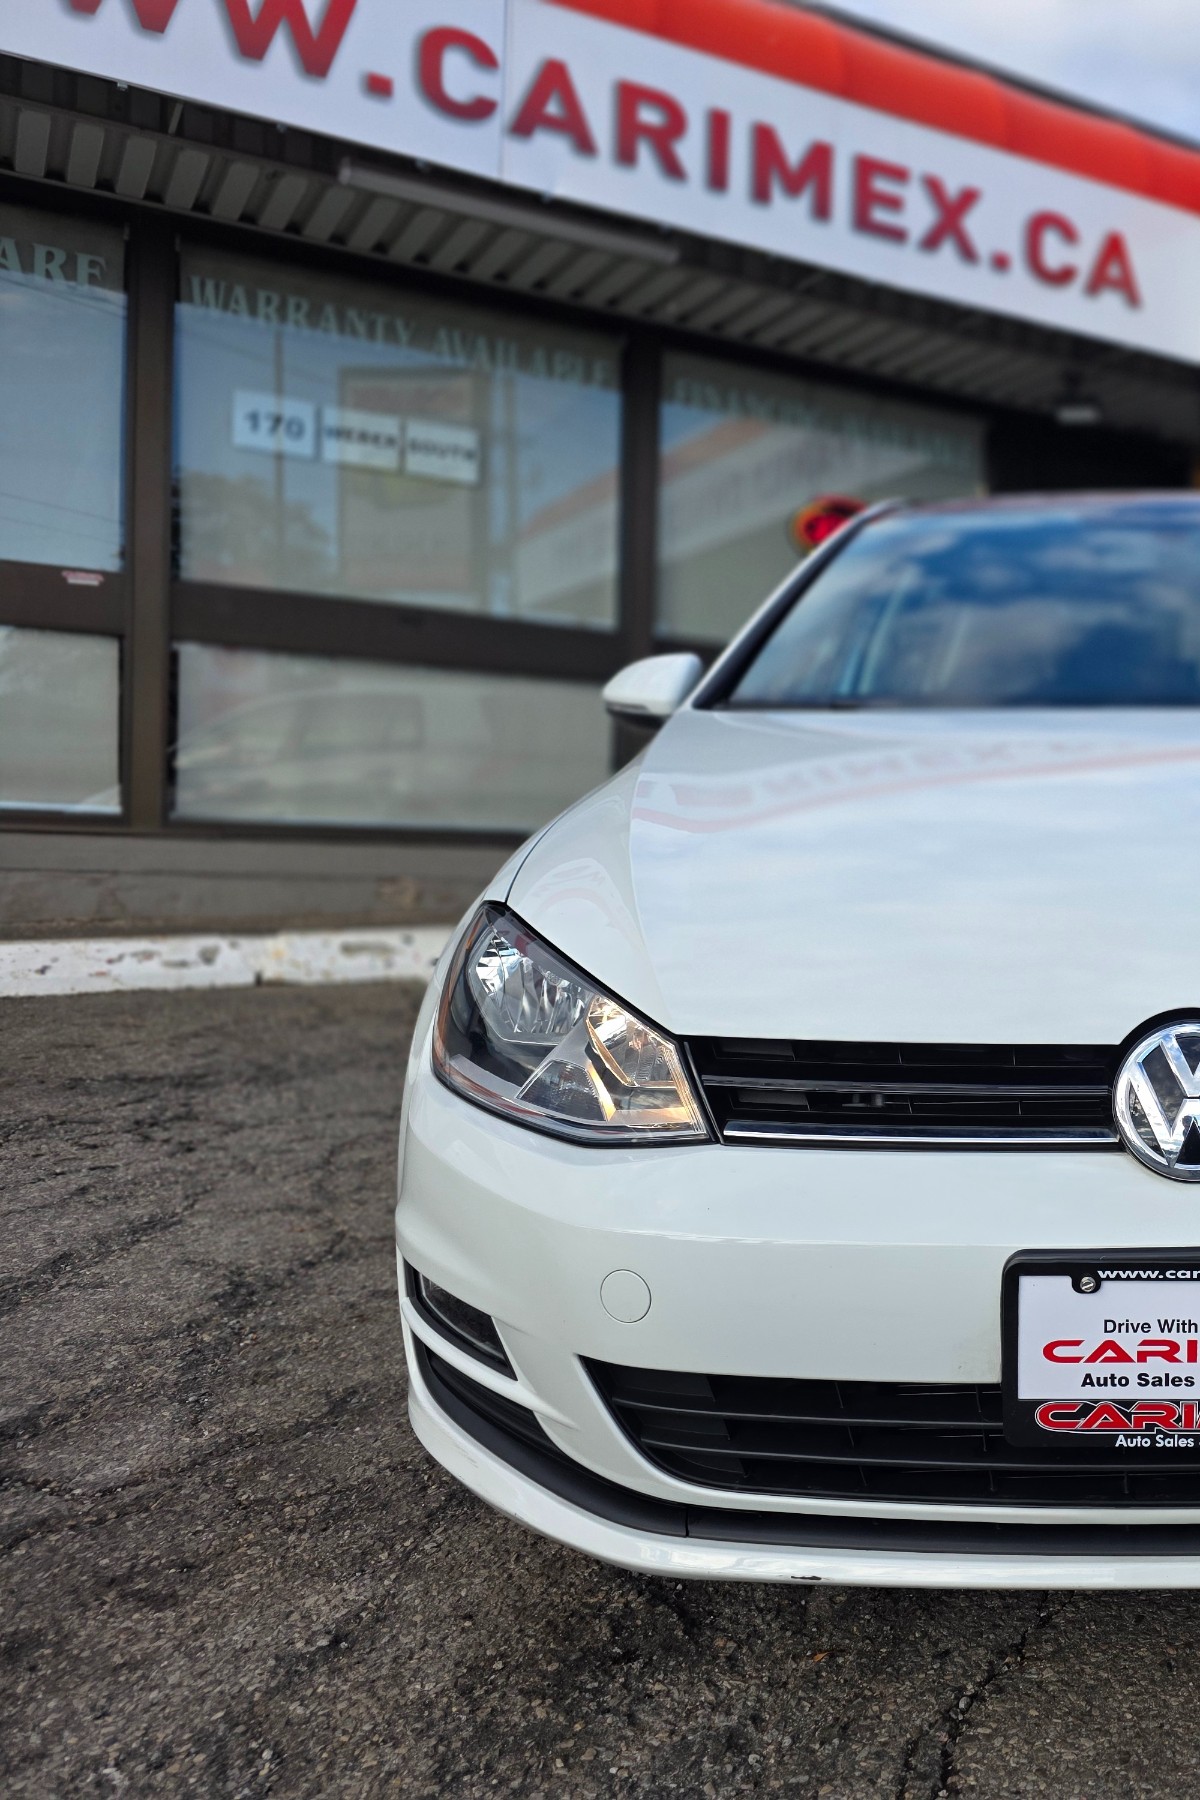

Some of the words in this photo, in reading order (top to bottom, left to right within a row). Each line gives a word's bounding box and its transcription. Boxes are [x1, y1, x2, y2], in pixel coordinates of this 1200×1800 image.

[65, 0, 1143, 309] W.CARIMEX.CA
[189, 274, 419, 349] WARRANTY
[243, 407, 306, 441] 170
[1103, 1318, 1152, 1334] Drive
[1157, 1318, 1199, 1334] With
[1081, 1373, 1130, 1388] Auto
[1137, 1372, 1195, 1388] Sales
[1115, 1434, 1151, 1447] Auto
[1155, 1434, 1195, 1448] Sales
